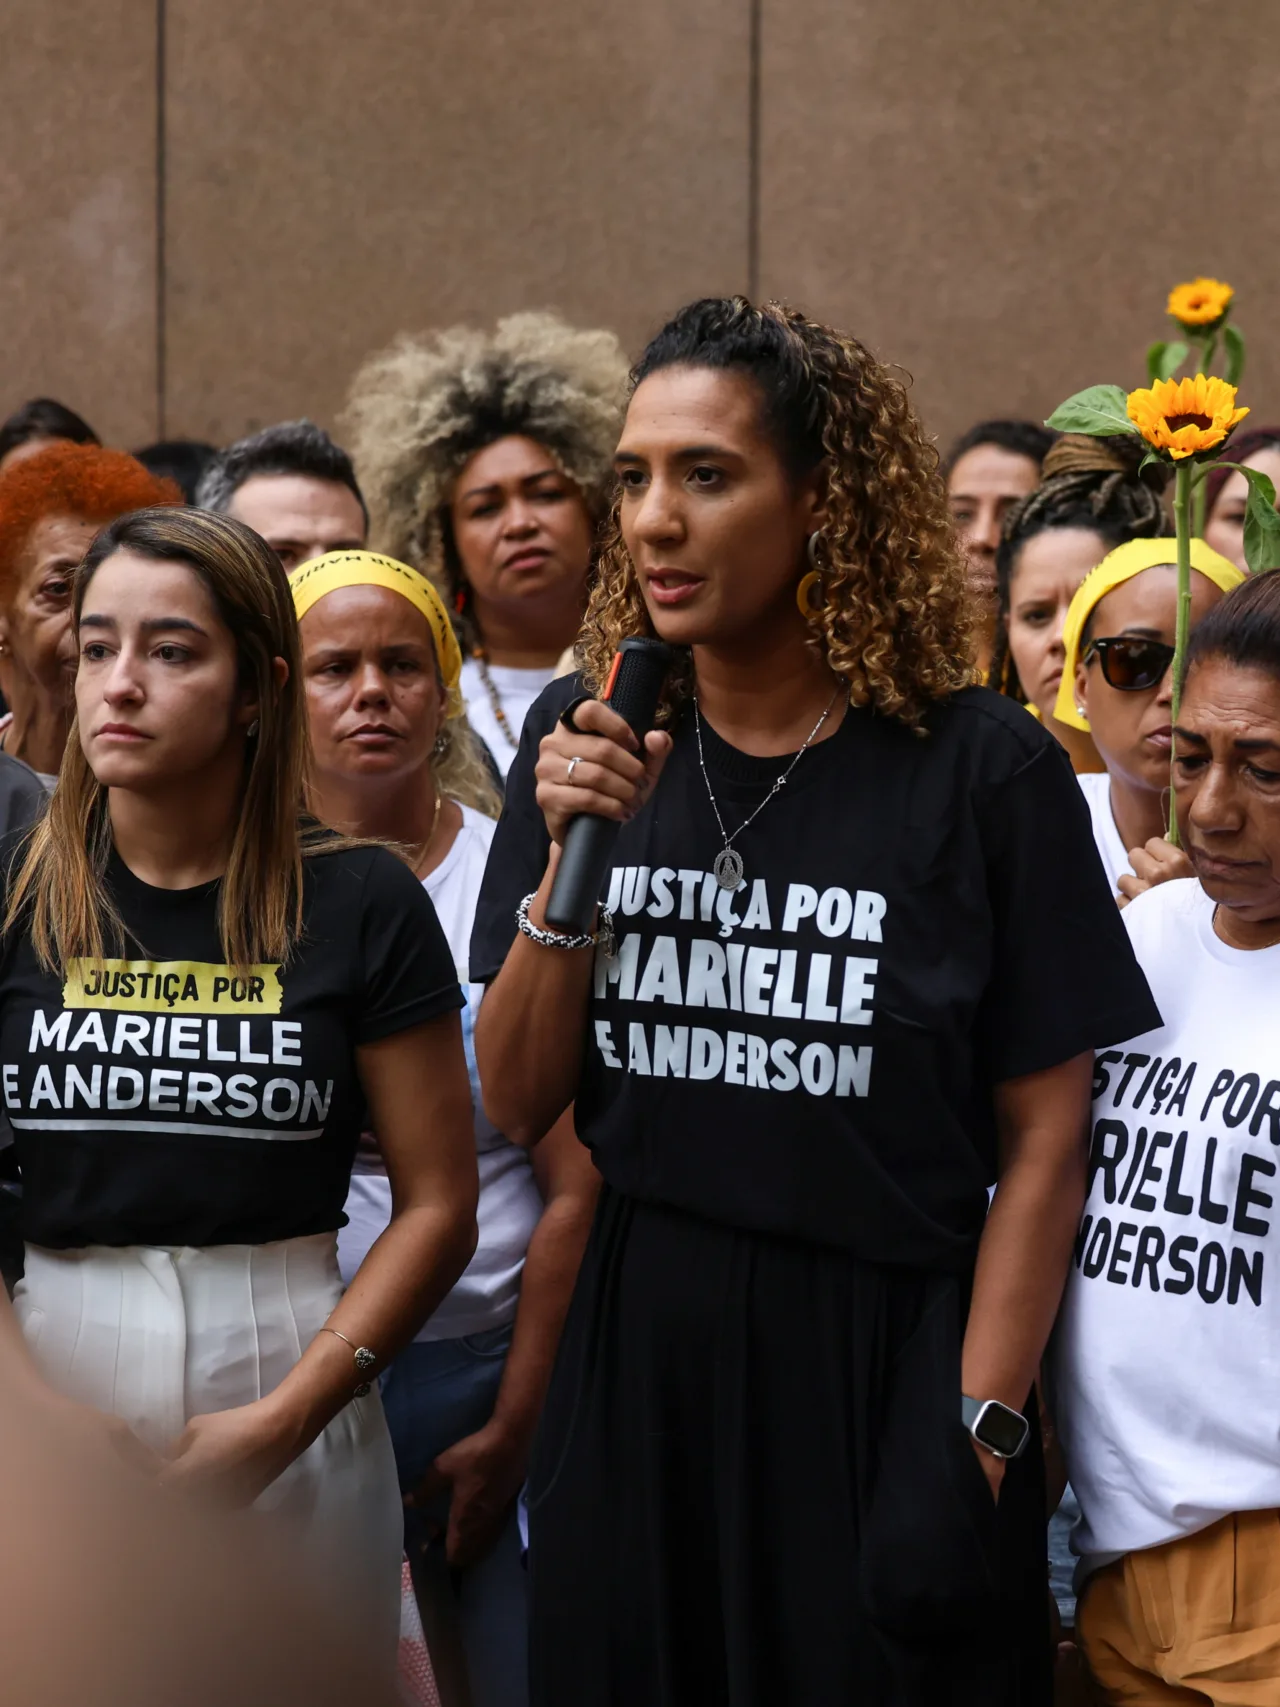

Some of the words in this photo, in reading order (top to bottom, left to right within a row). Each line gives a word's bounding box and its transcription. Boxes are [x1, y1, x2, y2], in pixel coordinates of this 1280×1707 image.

[606, 866, 771, 937] JUSTIÇA
[782, 883, 887, 943] POR
[84, 969, 199, 1008] JUSTIÇA
[213, 975, 265, 1003] POR
[594, 933, 879, 1026] MARIELLE
[28, 1009, 302, 1066] MARIELLE
[628, 1022, 873, 1098] ANDERSON
[2, 1064, 21, 1110] E
[30, 1064, 334, 1123] ANDERSON
